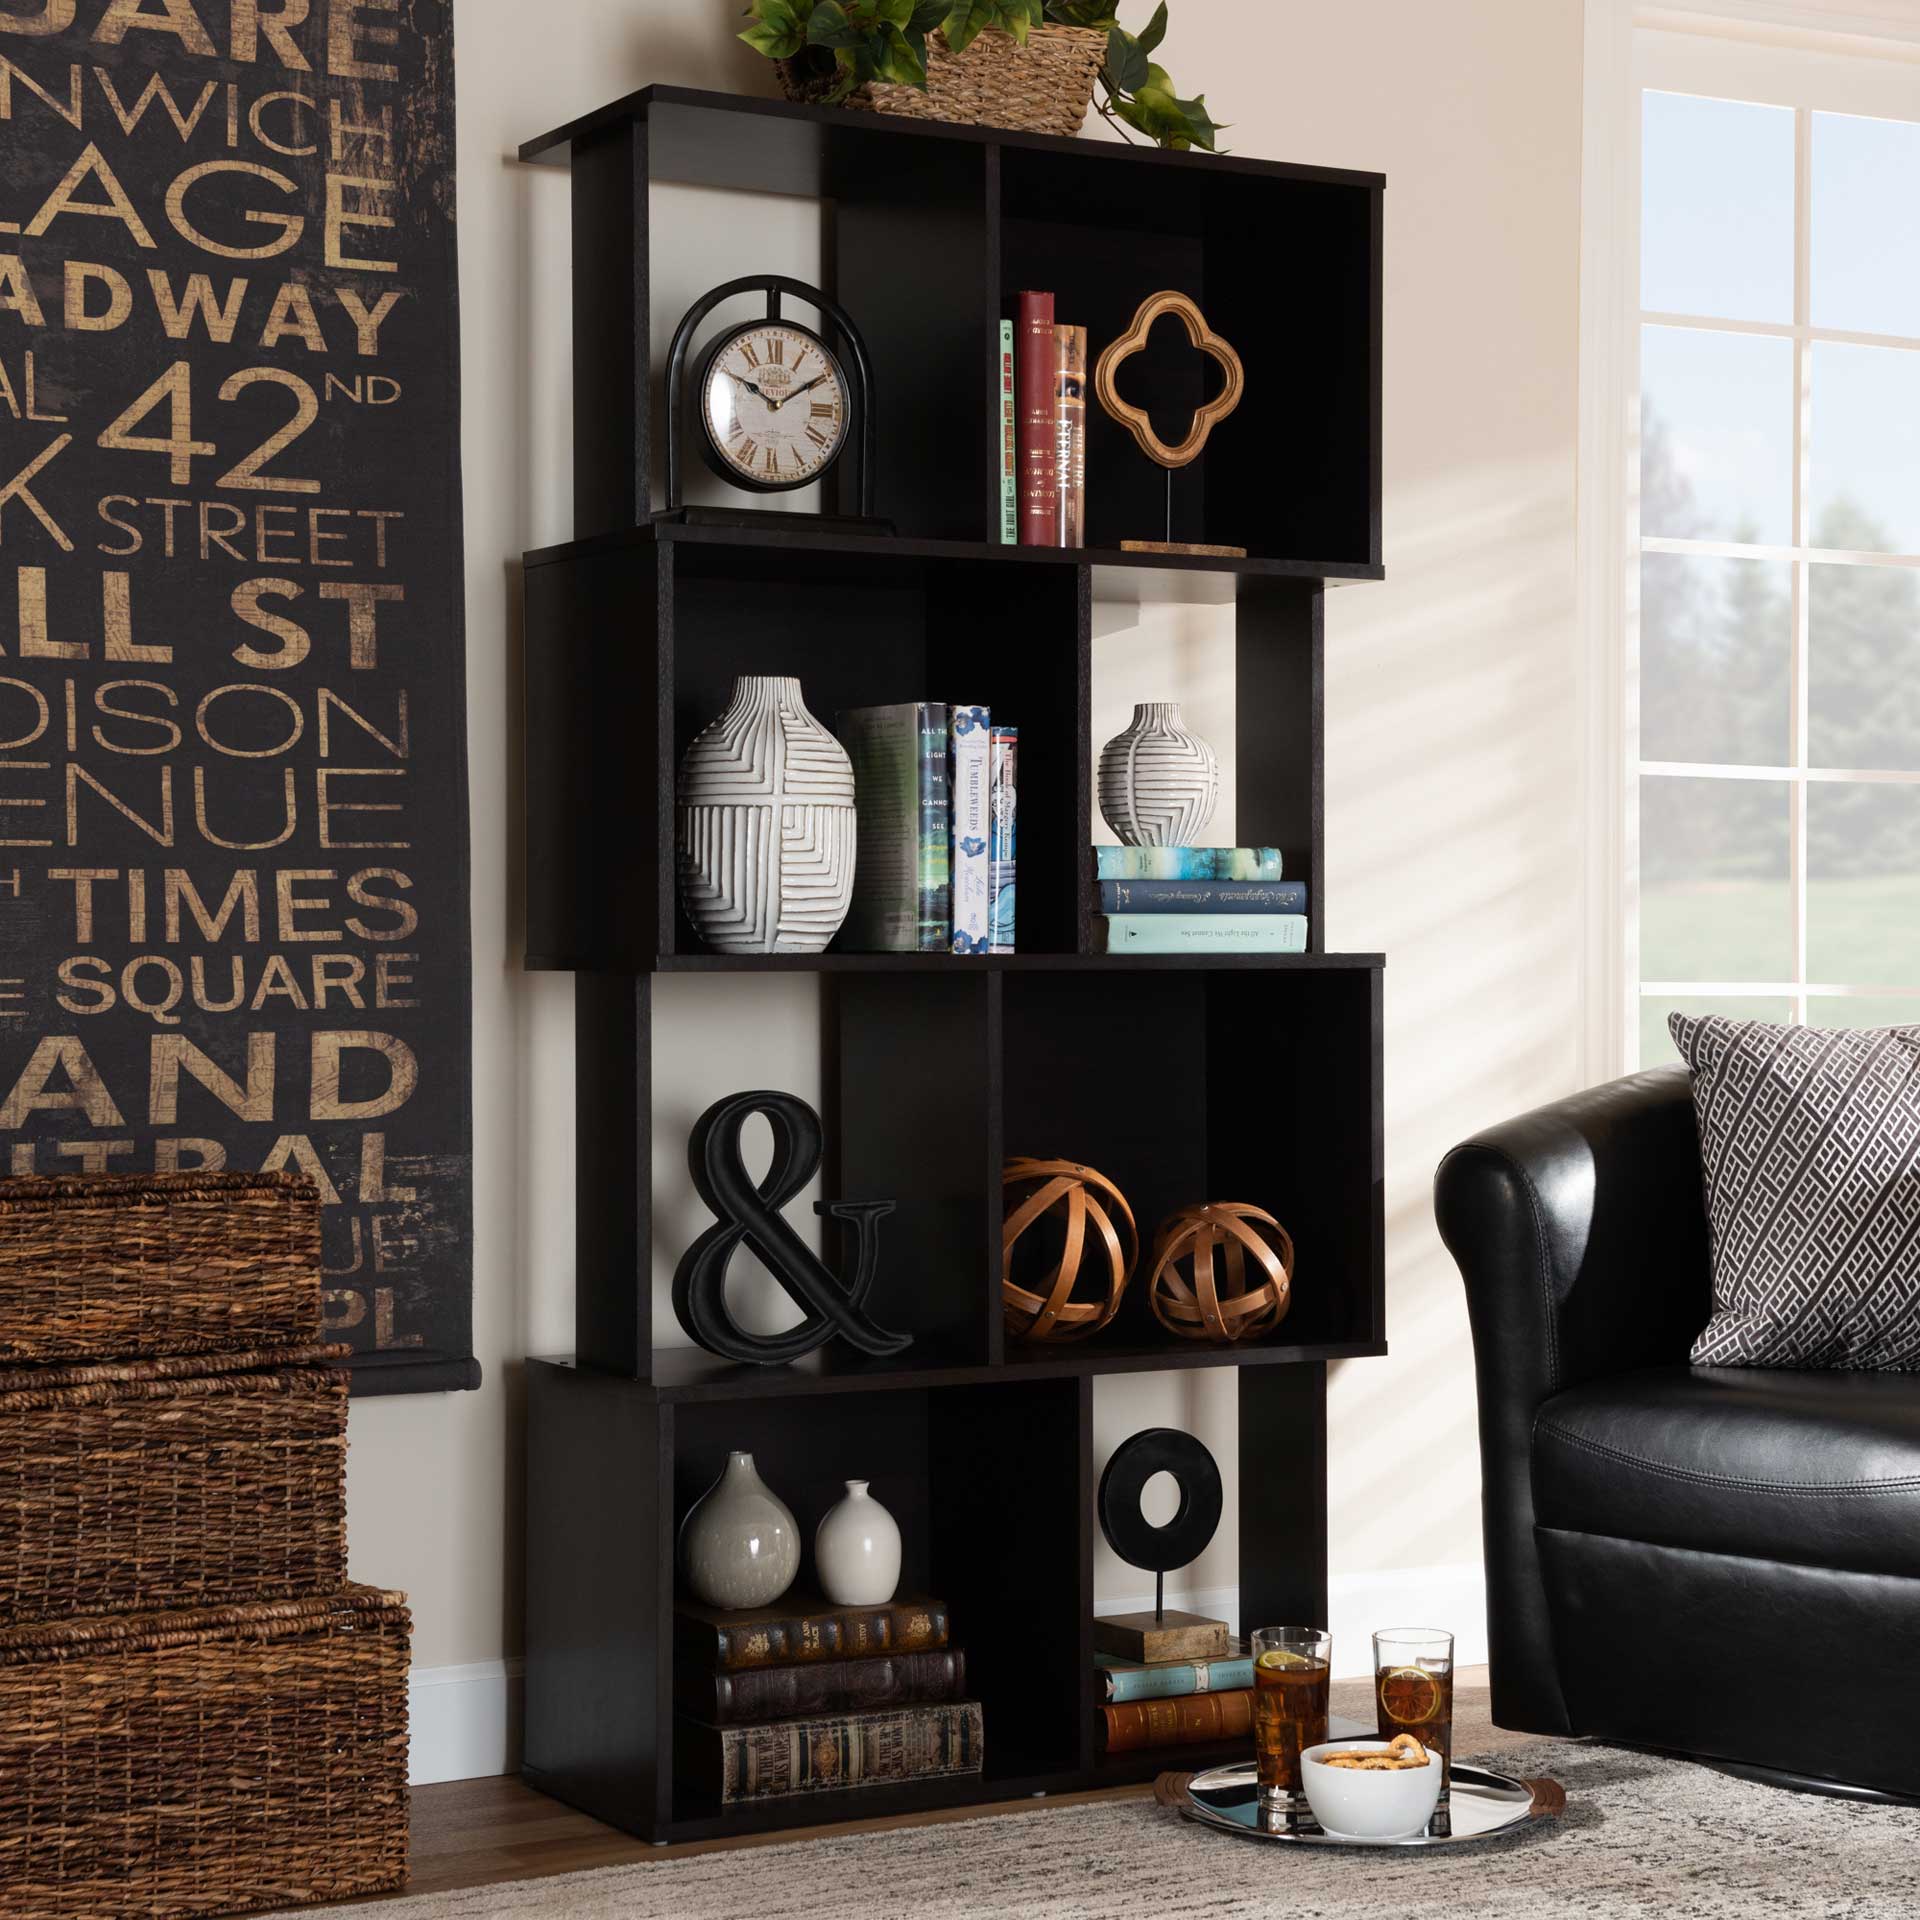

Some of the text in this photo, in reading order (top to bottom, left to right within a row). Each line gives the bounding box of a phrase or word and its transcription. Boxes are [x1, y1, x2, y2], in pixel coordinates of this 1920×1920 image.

[0, 140, 398, 272] AGE
[1056, 419, 1073, 492] ETERNAL
[1072, 454, 1084, 489] FIRE
[97, 494, 405, 568] STREET
[0, 566, 405, 670] LL ST
[968, 757, 983, 831] TUMBLEWEEDS
[48, 867, 419, 943] TIMES
[55, 952, 420, 1024] SQUARE
[0, 1029, 419, 1130] AND
